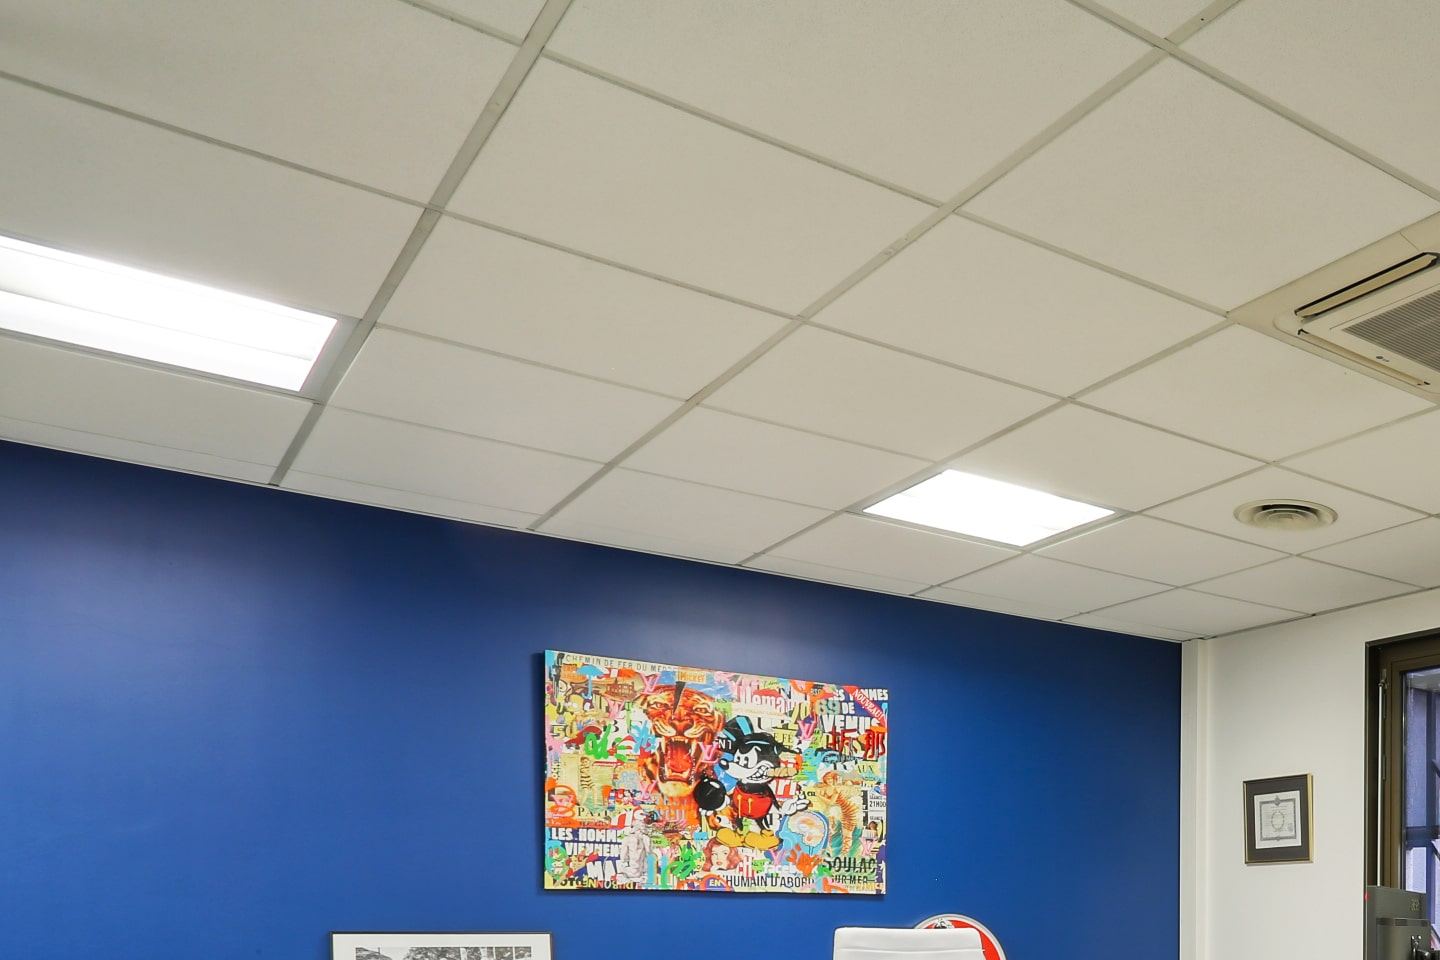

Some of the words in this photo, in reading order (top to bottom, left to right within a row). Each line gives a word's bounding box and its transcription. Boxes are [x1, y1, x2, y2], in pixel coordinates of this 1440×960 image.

[551, 827, 573, 840] LES
[579, 828, 618, 841] HOMM
[565, 842, 620, 857] VIENNEN
